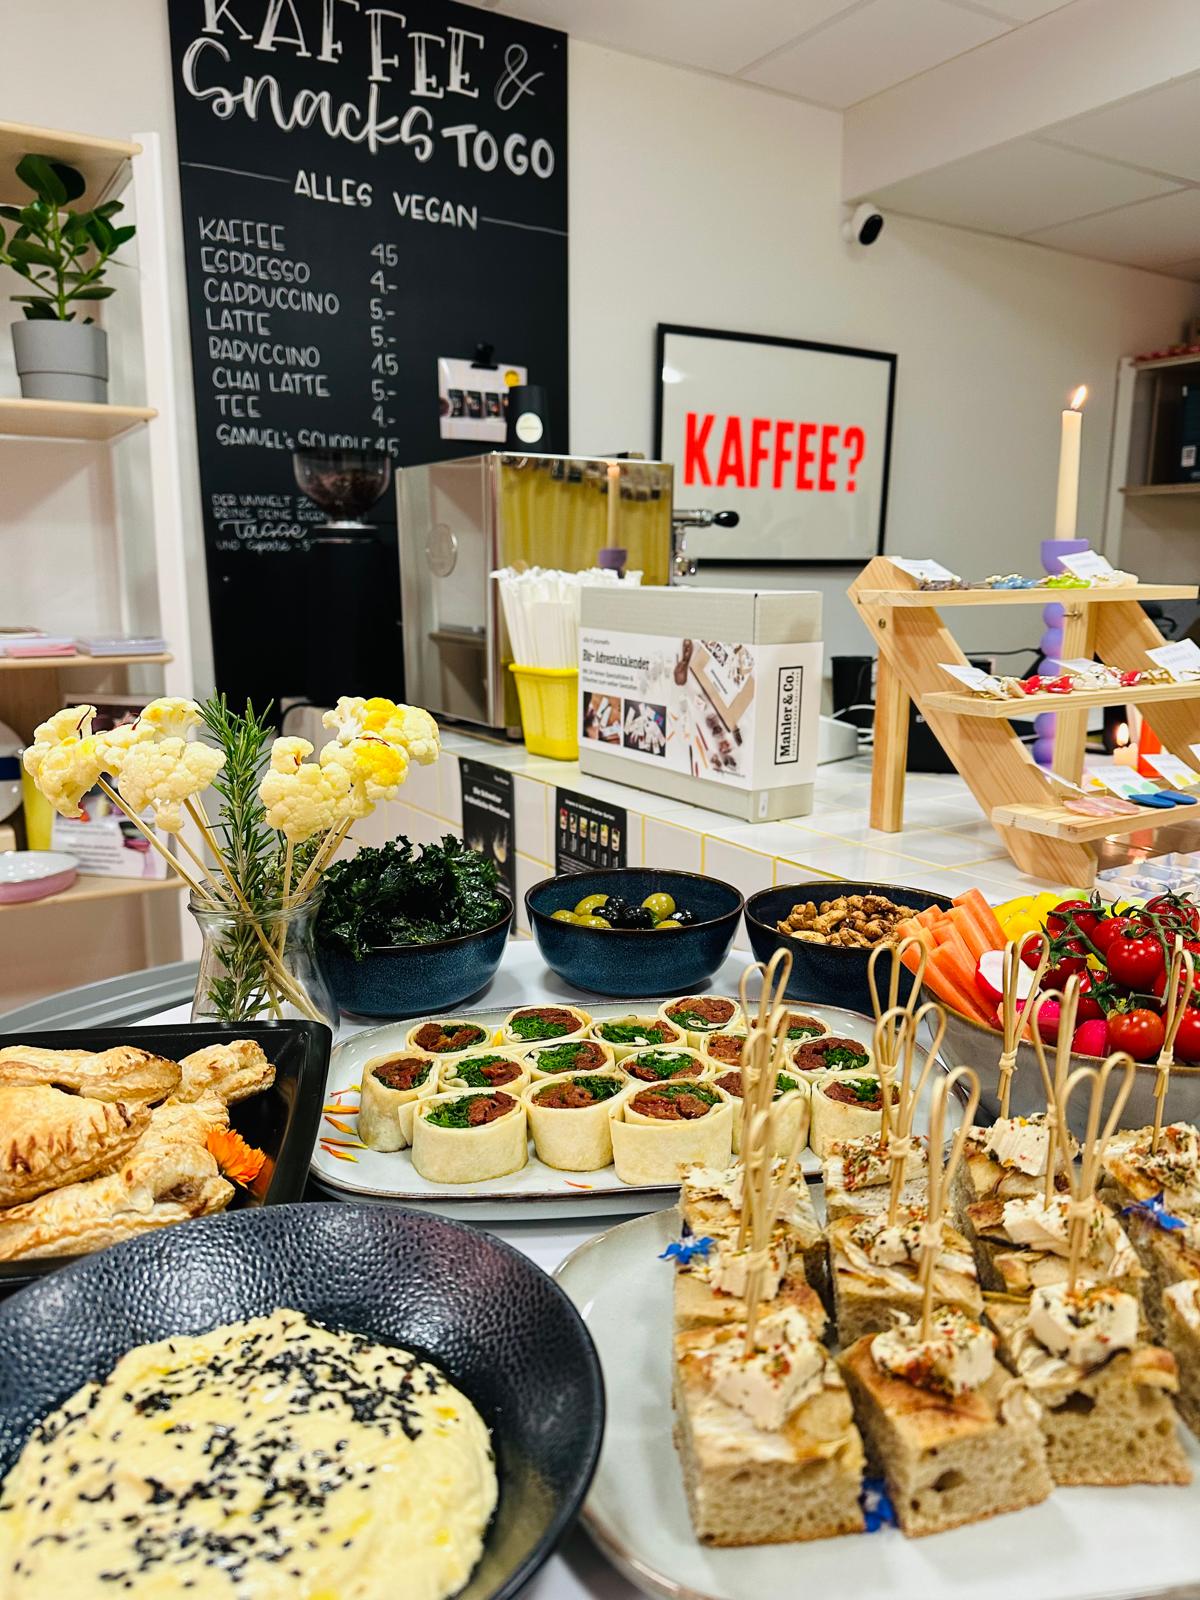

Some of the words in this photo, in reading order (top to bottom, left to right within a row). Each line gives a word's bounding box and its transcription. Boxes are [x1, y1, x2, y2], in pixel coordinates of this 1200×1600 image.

[202, 0, 484, 98] KAFFEE
[494, 43, 545, 110] &
[182, 37, 433, 162] Snacks
[294, 170, 373, 207] ALLES
[393, 192, 478, 230] VEGAN
[198, 216, 286, 251] KAFFEE
[200, 247, 311, 284] ESPRESSO
[204, 277, 340, 315] CAPPUCCINO
[206, 308, 271, 336] LATTE
[212, 366, 260, 391] CHAI
[269, 371, 331, 397] LATTE
[214, 394, 262, 418] TEE
[684, 412, 866, 493] KAFFEE?
[782, 693, 793, 706] &
[783, 671, 795, 692] Co.
[780, 706, 793, 758] Mahler
